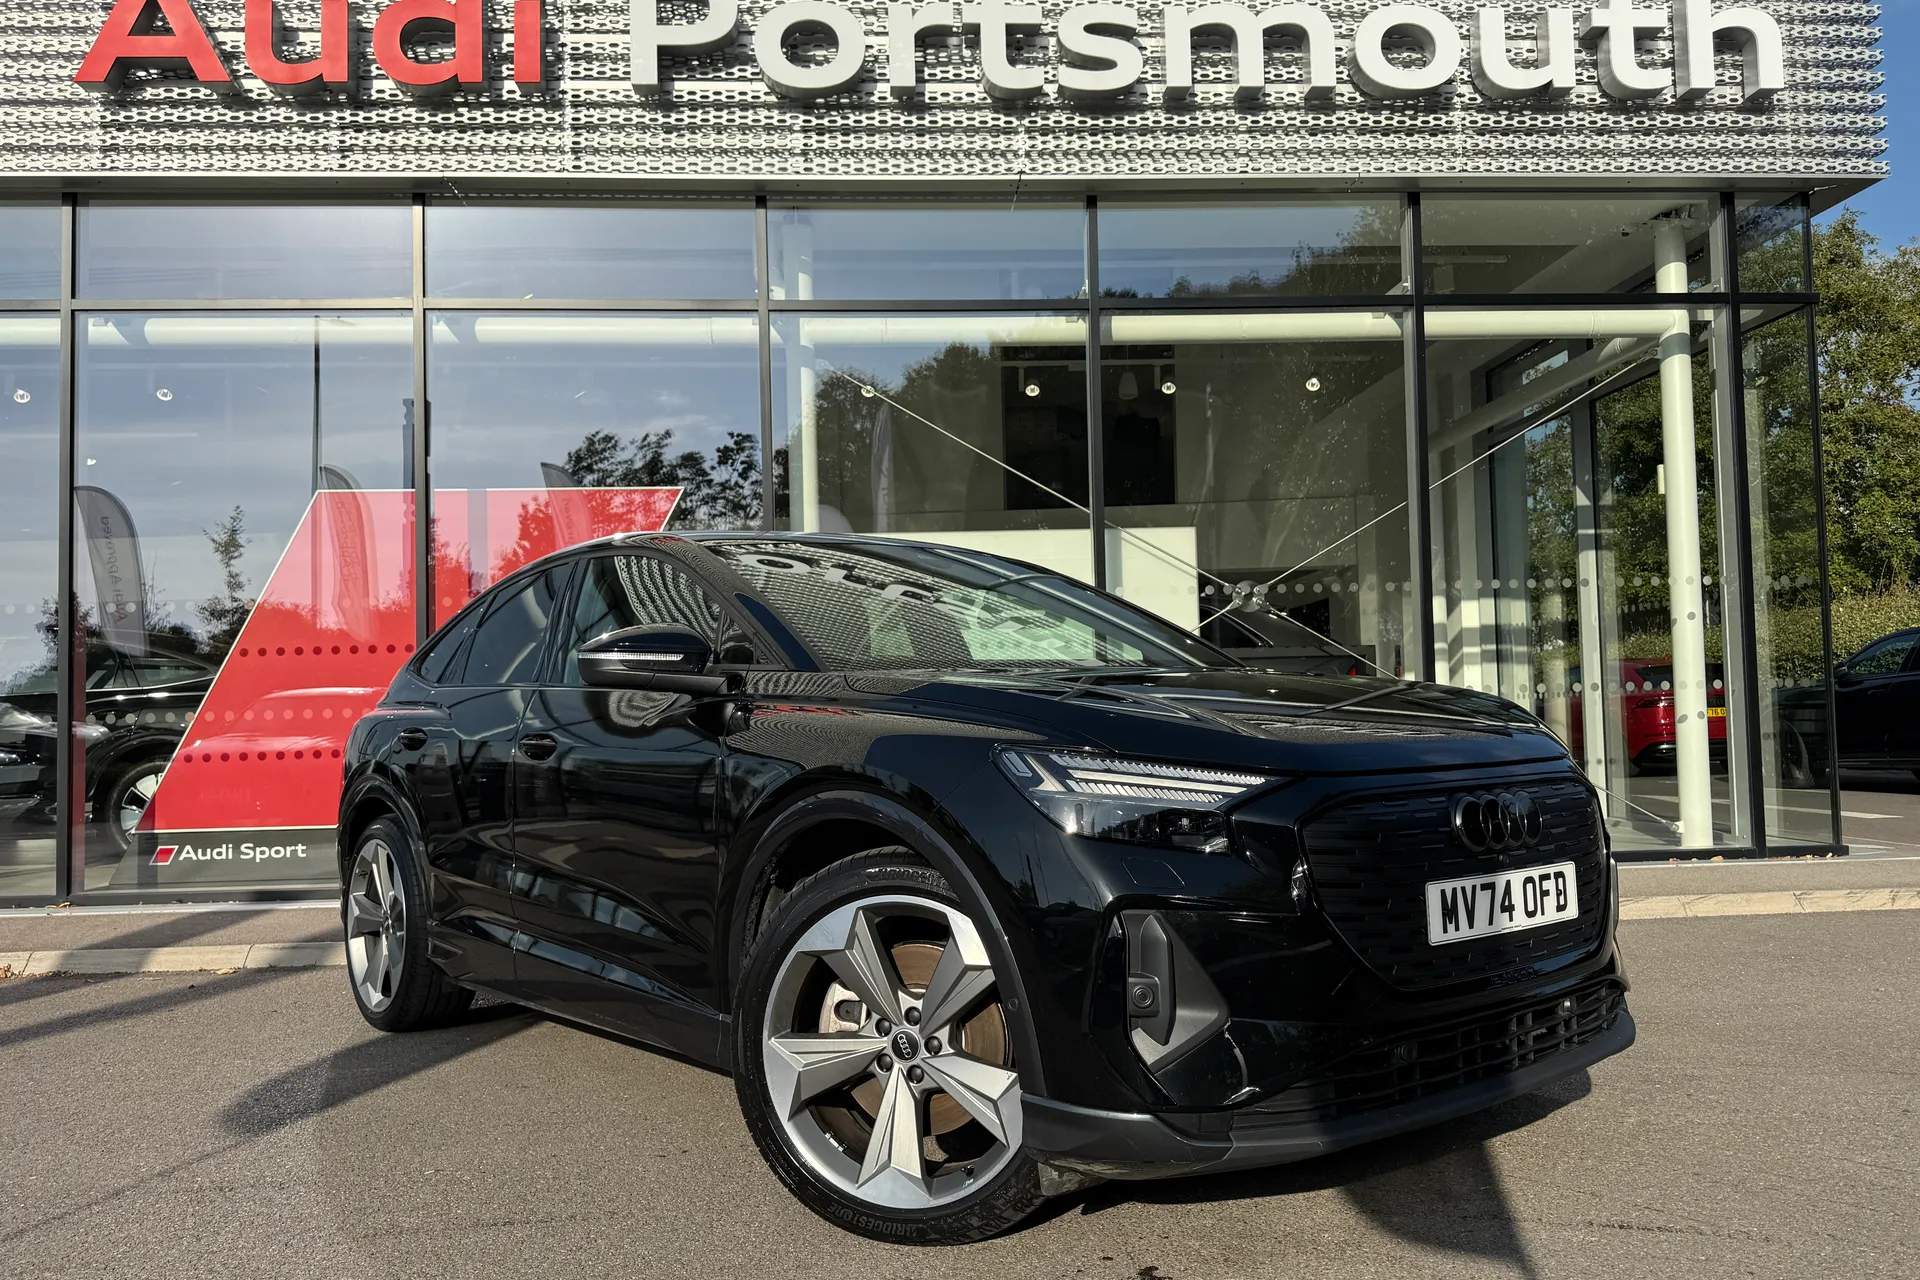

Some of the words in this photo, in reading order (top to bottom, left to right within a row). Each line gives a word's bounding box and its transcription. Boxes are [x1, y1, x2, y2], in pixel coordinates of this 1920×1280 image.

[73, 0, 541, 86] Audi
[630, 0, 1784, 95] Portsmouth
[178, 843, 233, 861] Audi
[240, 843, 307, 863] Sport
[1440, 879, 1516, 935] MV74
[1522, 870, 1568, 919] OFD
[827, 1202, 918, 1238] BRIDGESTONE
